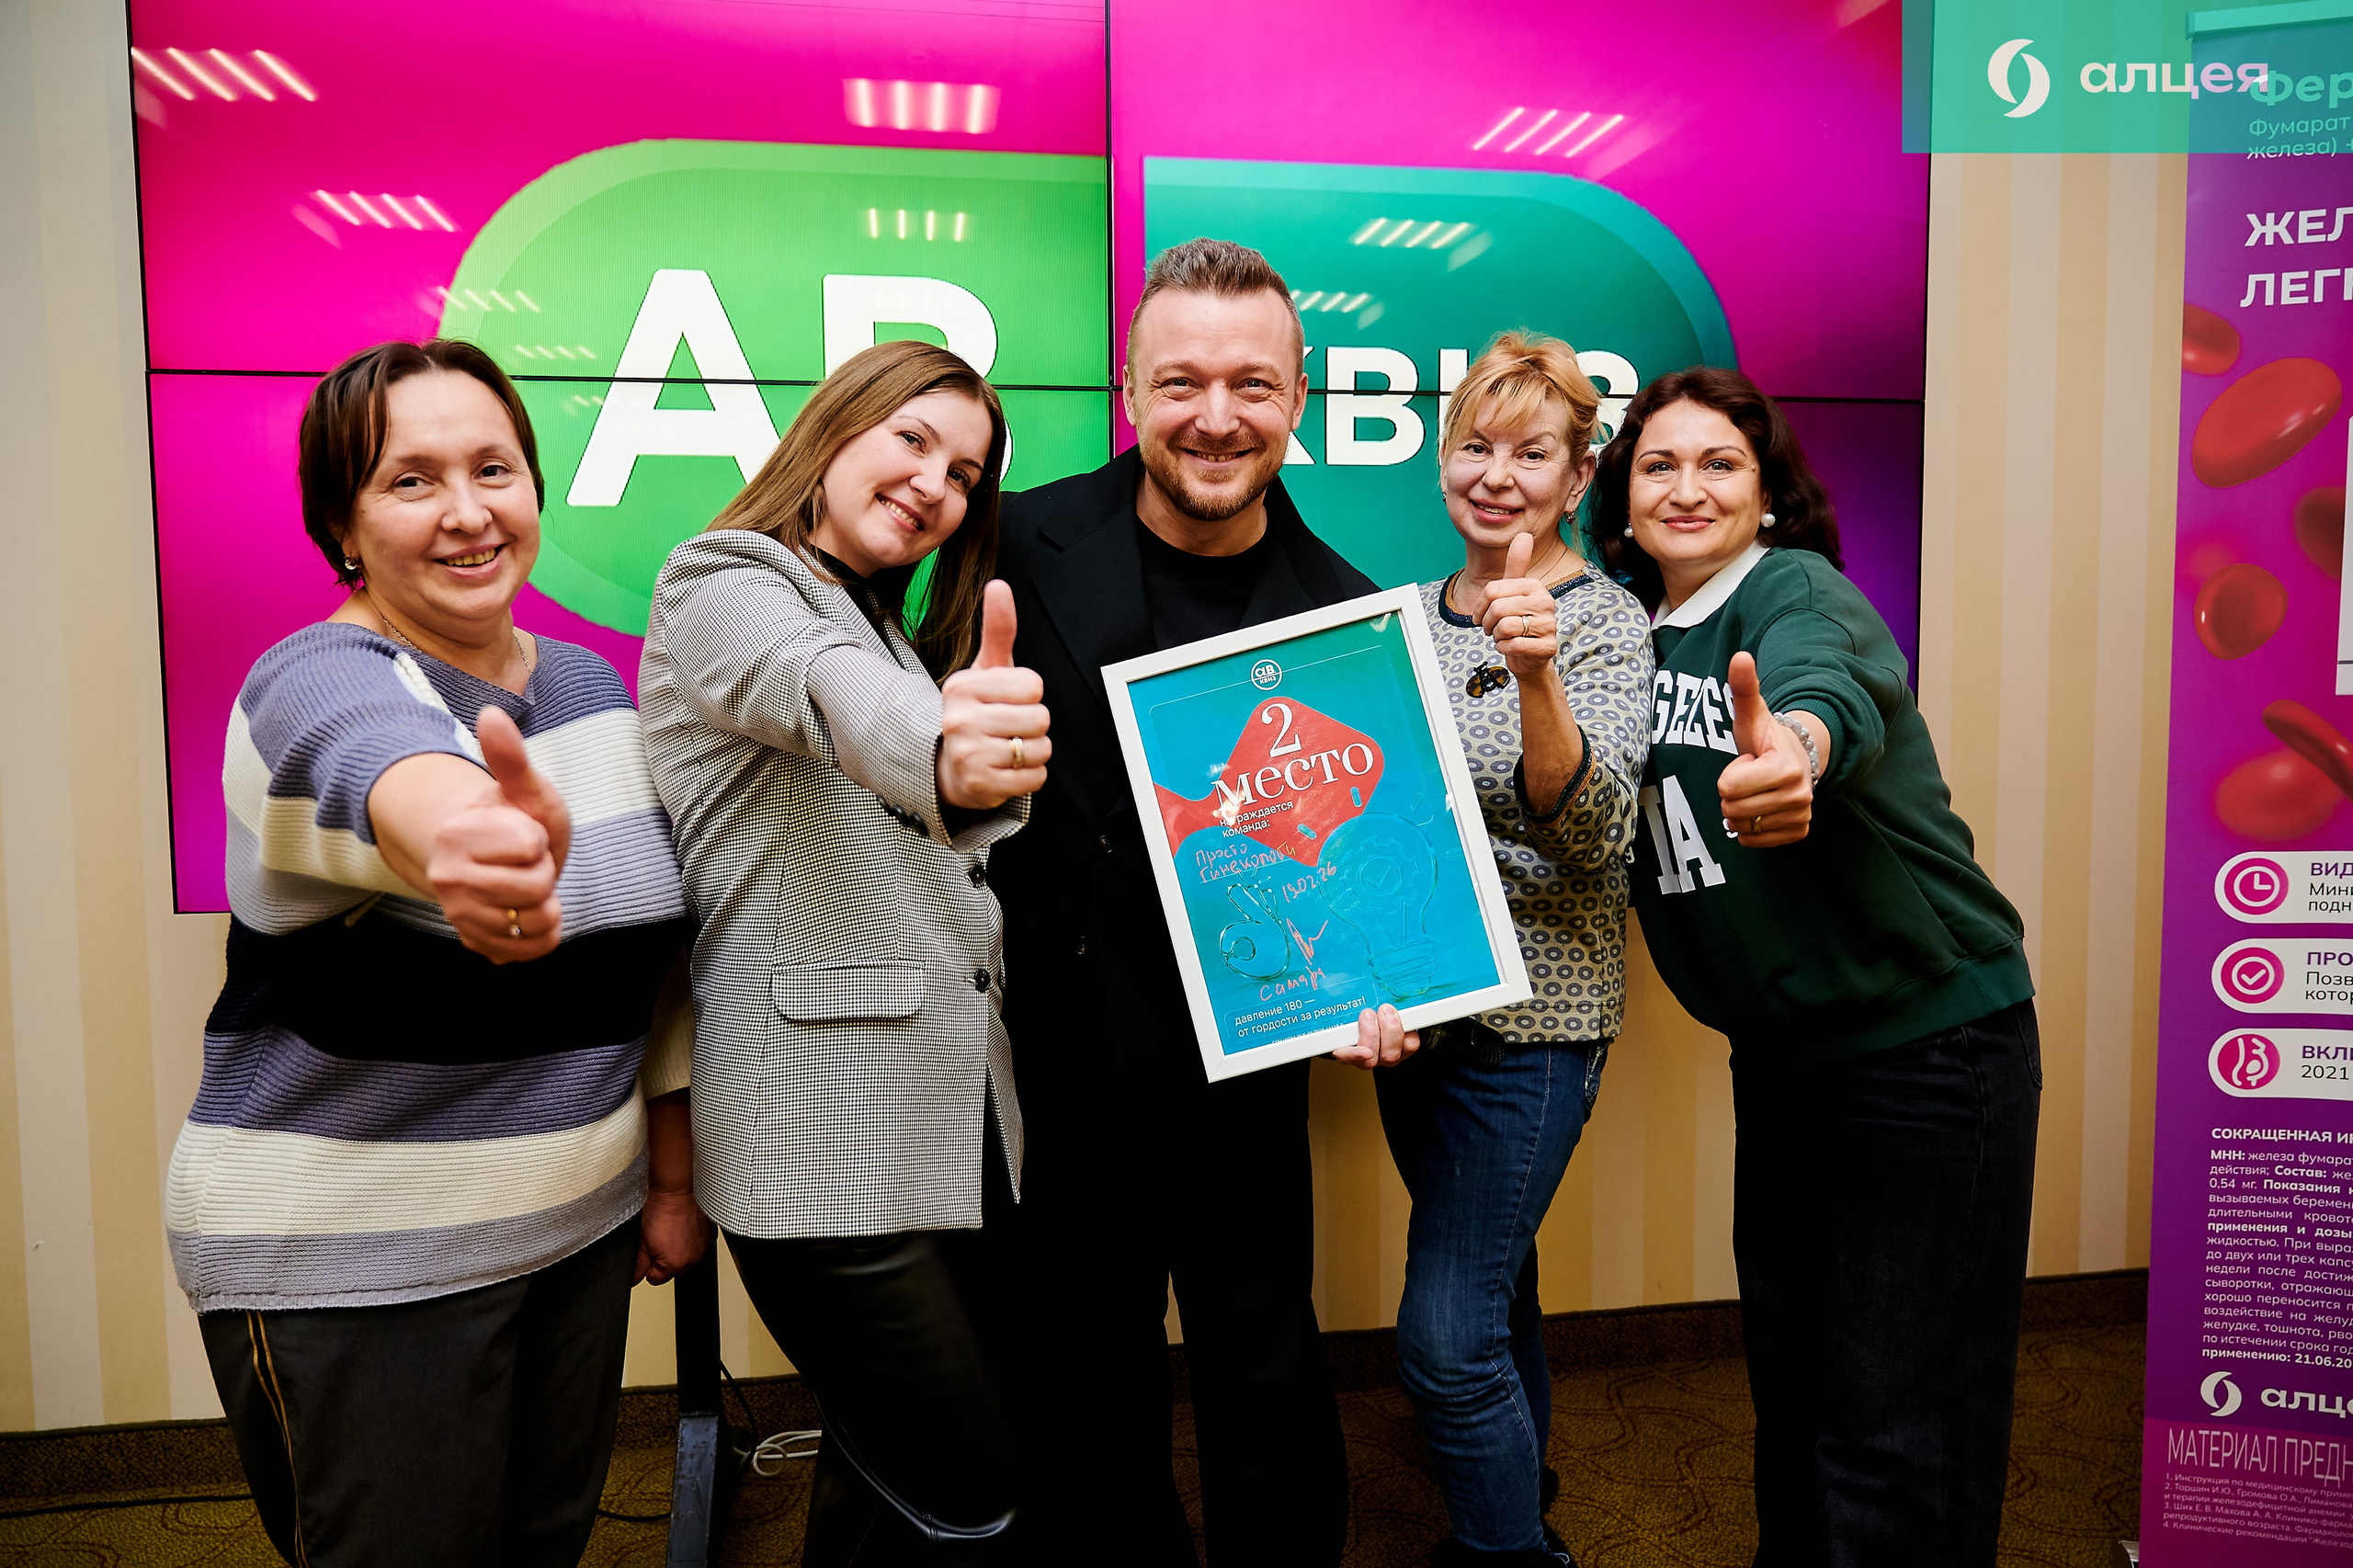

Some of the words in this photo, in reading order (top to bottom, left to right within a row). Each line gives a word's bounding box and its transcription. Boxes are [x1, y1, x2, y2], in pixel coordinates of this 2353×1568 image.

[2249, 117, 2350, 140] Фумарат
[2247, 137, 2337, 160] железа)
[1260, 701, 1302, 759] 2
[1220, 801, 1294, 827] нараждается
[1222, 819, 1271, 838] команда:
[1196, 843, 1248, 869] Просто
[2308, 902, 2351, 913] подн
[2307, 952, 2353, 966] ПРО
[1260, 965, 1326, 1001] Самара
[1235, 1006, 1283, 1027] давление
[1284, 999, 1302, 1012] 180
[1237, 1028, 1249, 1038] от
[1252, 1015, 1299, 1035] гордости
[1301, 1013, 1312, 1021] за
[1314, 996, 1367, 1018] результат!
[2302, 1064, 2349, 1080] 2021
[2211, 1128, 2332, 1142] СОКРАЩЕННАЯ
[2211, 1150, 2245, 1160] МНН:
[2248, 1153, 2295, 1162] железа
[2298, 1152, 2353, 1166] фумара
[2210, 1165, 2269, 1176] действия;
[2275, 1165, 2327, 1178] Состав:
[2332, 1171, 2353, 1180] же
[2264, 1179, 2341, 1194] Показания
[2209, 1194, 2289, 1204] вызываемых
[2293, 1194, 2353, 1210] беремен
[2208, 1209, 2292, 1219] длительными
[2304, 1212, 2353, 1224] кровот
[2208, 1222, 2288, 1233] применения
[2297, 1226, 2305, 1234] и
[2207, 1237, 2279, 1247] жидкостью.
[2285, 1237, 2311, 1250] При
[2316, 1242, 2353, 1255] выра
[2206, 1251, 2222, 1260] до
[2225, 1252, 2254, 1261] двух
[2257, 1253, 2280, 1261] или
[2286, 1254, 2315, 1265] трех
[2319, 1257, 2353, 1270] капс
[2206, 1265, 2250, 1275] недели
[2258, 1267, 2296, 1277] после
[2205, 1278, 2274, 1290] сыворотки,
[2205, 1293, 2252, 1303] хорошо
[2256, 1295, 2341, 1310] переносится
[2204, 1307, 2283, 1319] воздействие
[2290, 1312, 2306, 1321] на
[2203, 1321, 2260, 1332] желудке,
[2264, 1324, 2324, 1337] тошнота,
[2221, 1335, 2287, 1347] истечении
[2290, 1340, 2330, 1353] срока
[2202, 1348, 2290, 1362] применению:
[2167, 1427, 2278, 1474] МАТЕРИАЛ
[2165, 1472, 2173, 1481] 1.
[2175, 1473, 2230, 1484] Инструкция
[2245, 1481, 2318, 1496] медицинскому
[2320, 1489, 2353, 1499] приме
[2165, 1482, 2173, 1490] 2.
[2175, 1483, 2210, 1493] Торшин
[2237, 1488, 2278, 1500] Громова
[2303, 1496, 2353, 1508] Лиманова
[2173, 1494, 2211, 1503] терапии
[2211, 1498, 2306, 1513] железодефицитной
[2174, 1503, 2193, 1511] Ших
[2215, 1506, 2251, 1517] Махова
[2163, 1512, 2245, 1526] репродуктивного
[2173, 1521, 2234, 1534] Клинические
[2235, 1529, 2307, 1543] рекомендации
